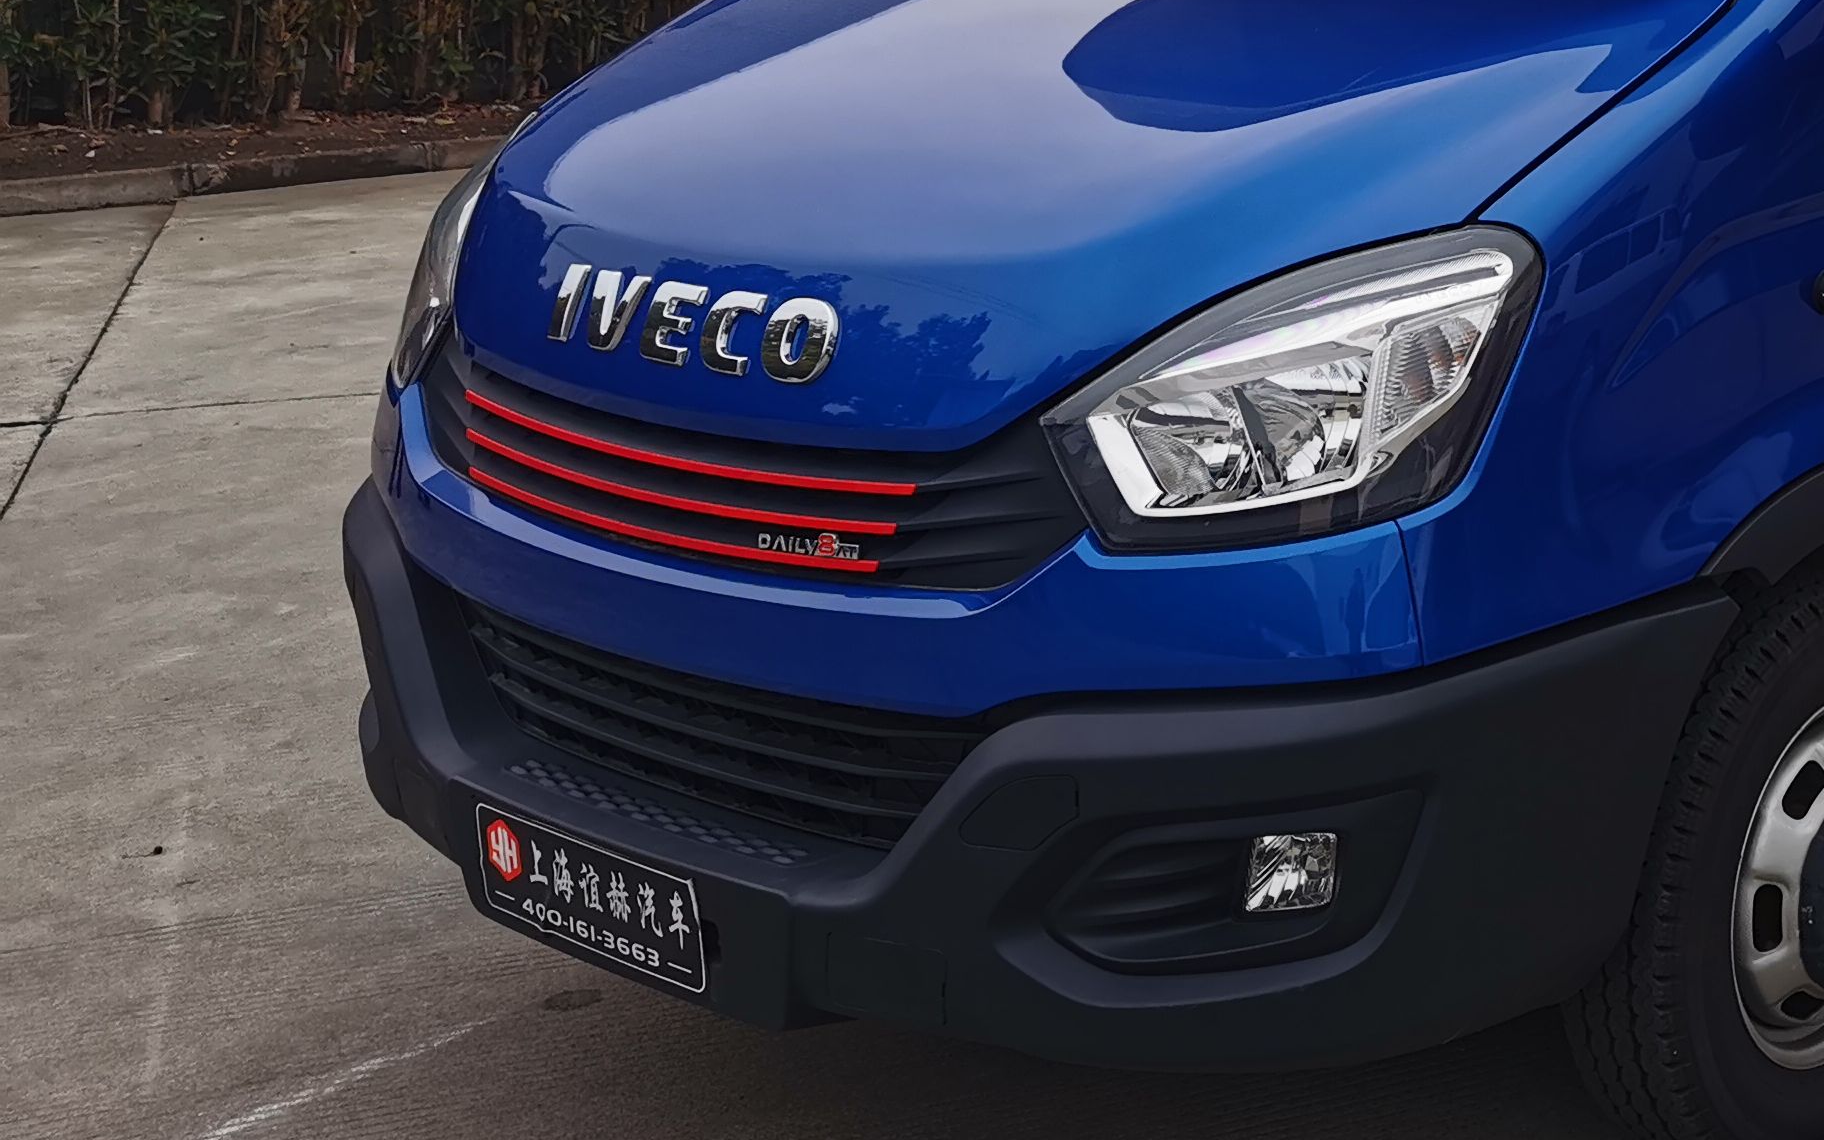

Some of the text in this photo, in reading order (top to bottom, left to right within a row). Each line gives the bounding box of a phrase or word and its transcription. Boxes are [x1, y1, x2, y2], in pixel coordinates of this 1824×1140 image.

[547, 263, 843, 384] IVECO
[522, 898, 660, 967] 400-161-3663
[529, 839, 691, 950] 上海谊赫汽车
